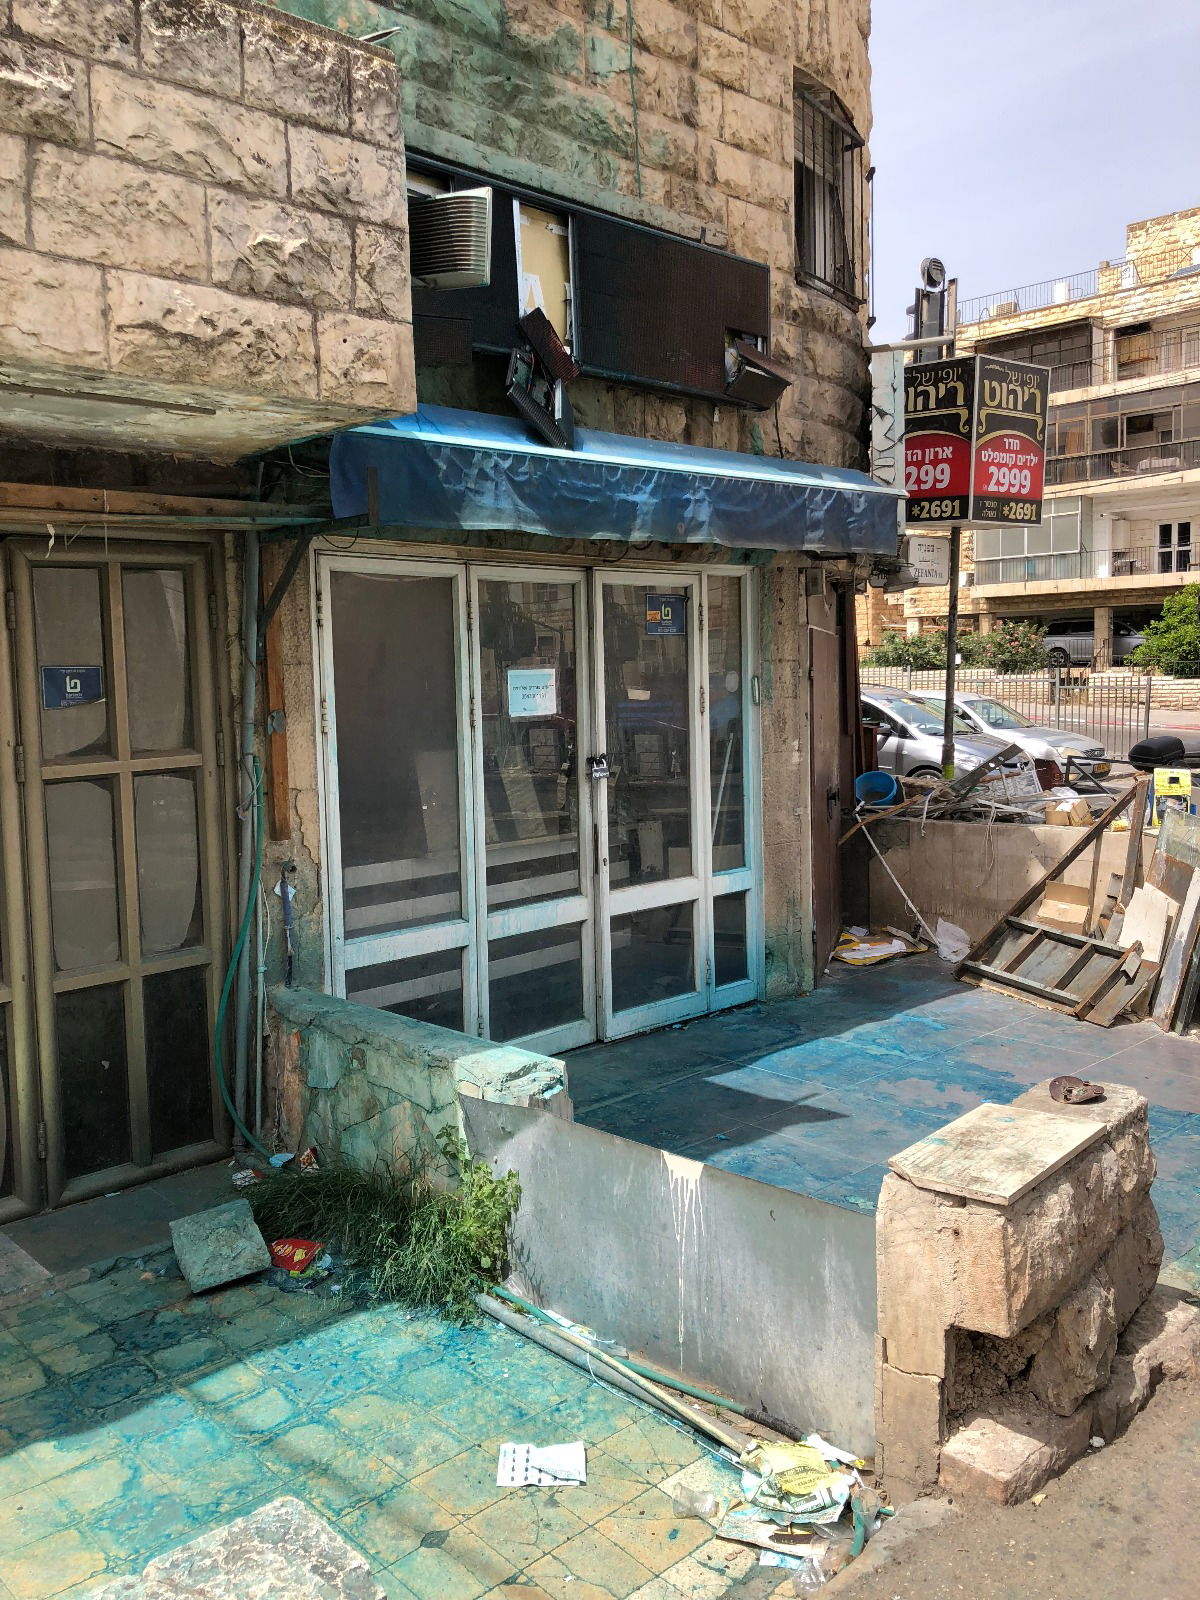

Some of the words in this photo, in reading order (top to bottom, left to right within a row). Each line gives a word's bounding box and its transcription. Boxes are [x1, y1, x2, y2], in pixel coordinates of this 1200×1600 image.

[912, 370, 935, 387] של
[939, 367, 962, 383] יופי
[1005, 366, 1021, 385] של
[1023, 373, 1040, 388] יופי
[904, 380, 965, 412] ריהו
[983, 379, 1041, 414] ריהוט
[1003, 437, 1020, 451] חדר
[925, 446, 953, 464] ארון
[981, 447, 1016, 467] קומפלט
[1017, 452, 1039, 467] ילדים
[987, 465, 1031, 495] 2999
